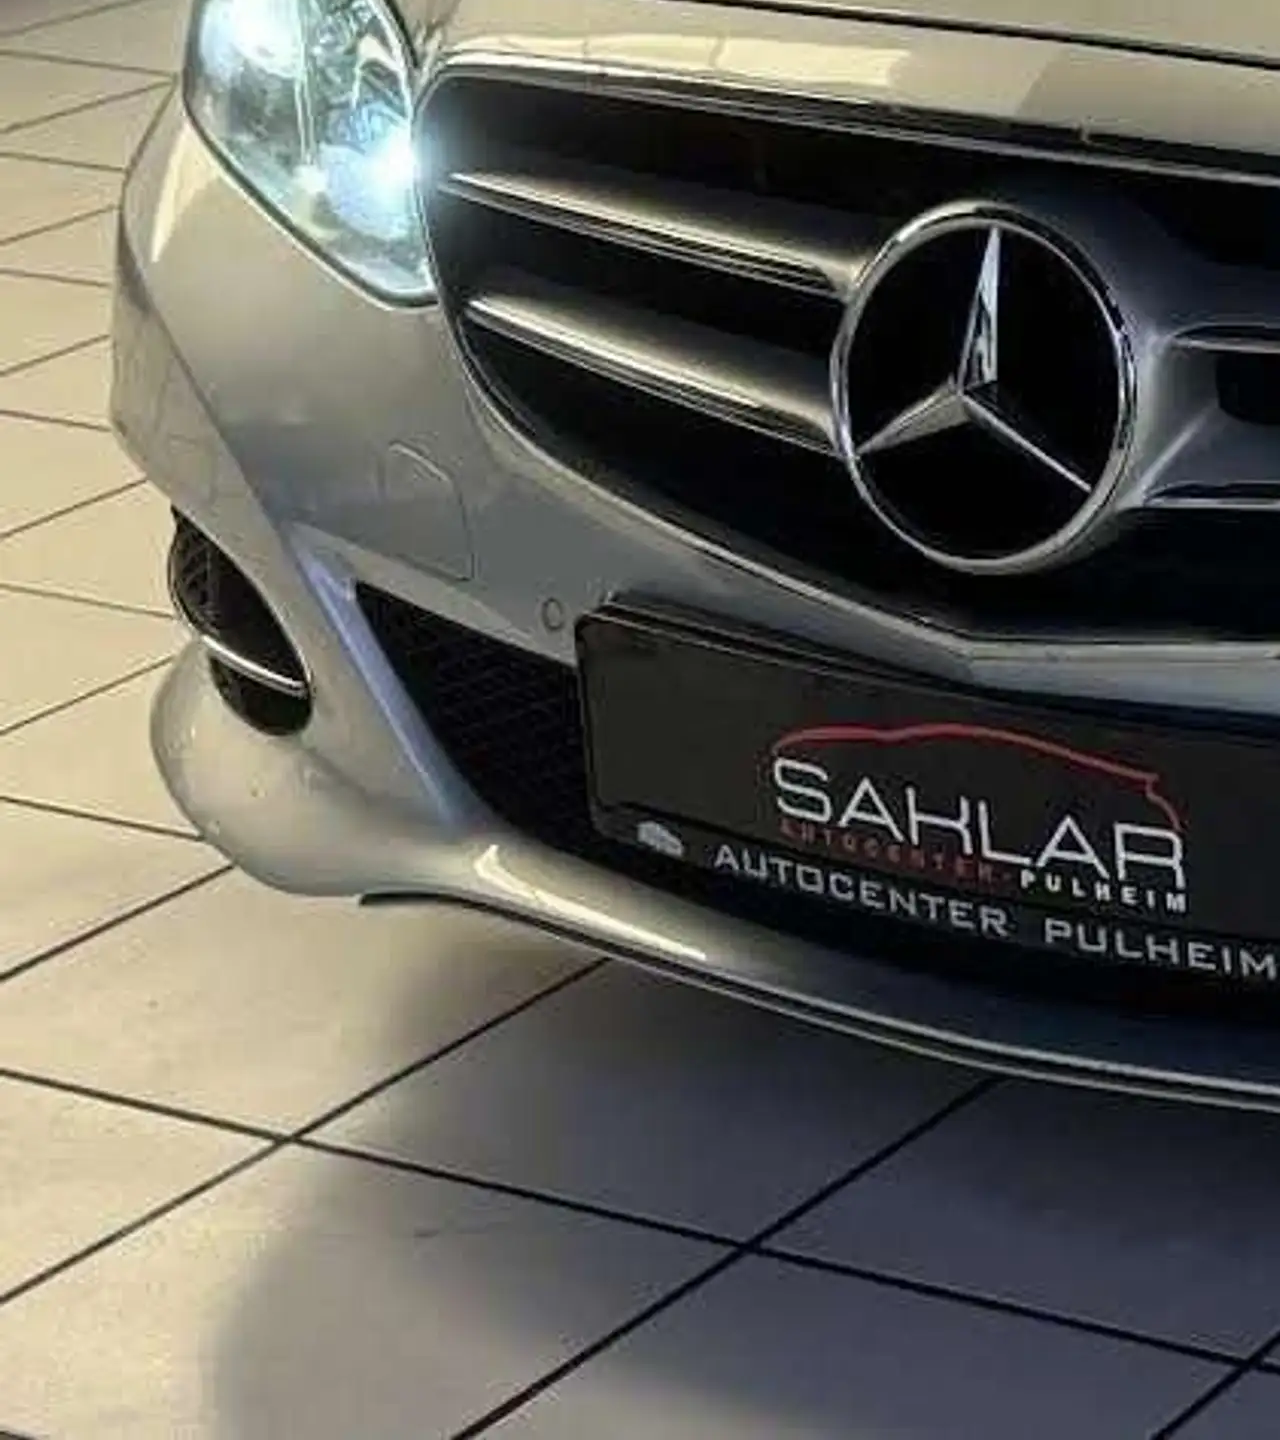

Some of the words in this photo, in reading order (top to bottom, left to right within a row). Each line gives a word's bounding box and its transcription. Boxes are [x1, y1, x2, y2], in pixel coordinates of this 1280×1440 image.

[773, 758, 1187, 890] SAHLAR
[713, 844, 1013, 938] AUTOCENTER
[1044, 917, 1278, 981] PULHEIM
[1020, 869, 1187, 913] PULHEIM
